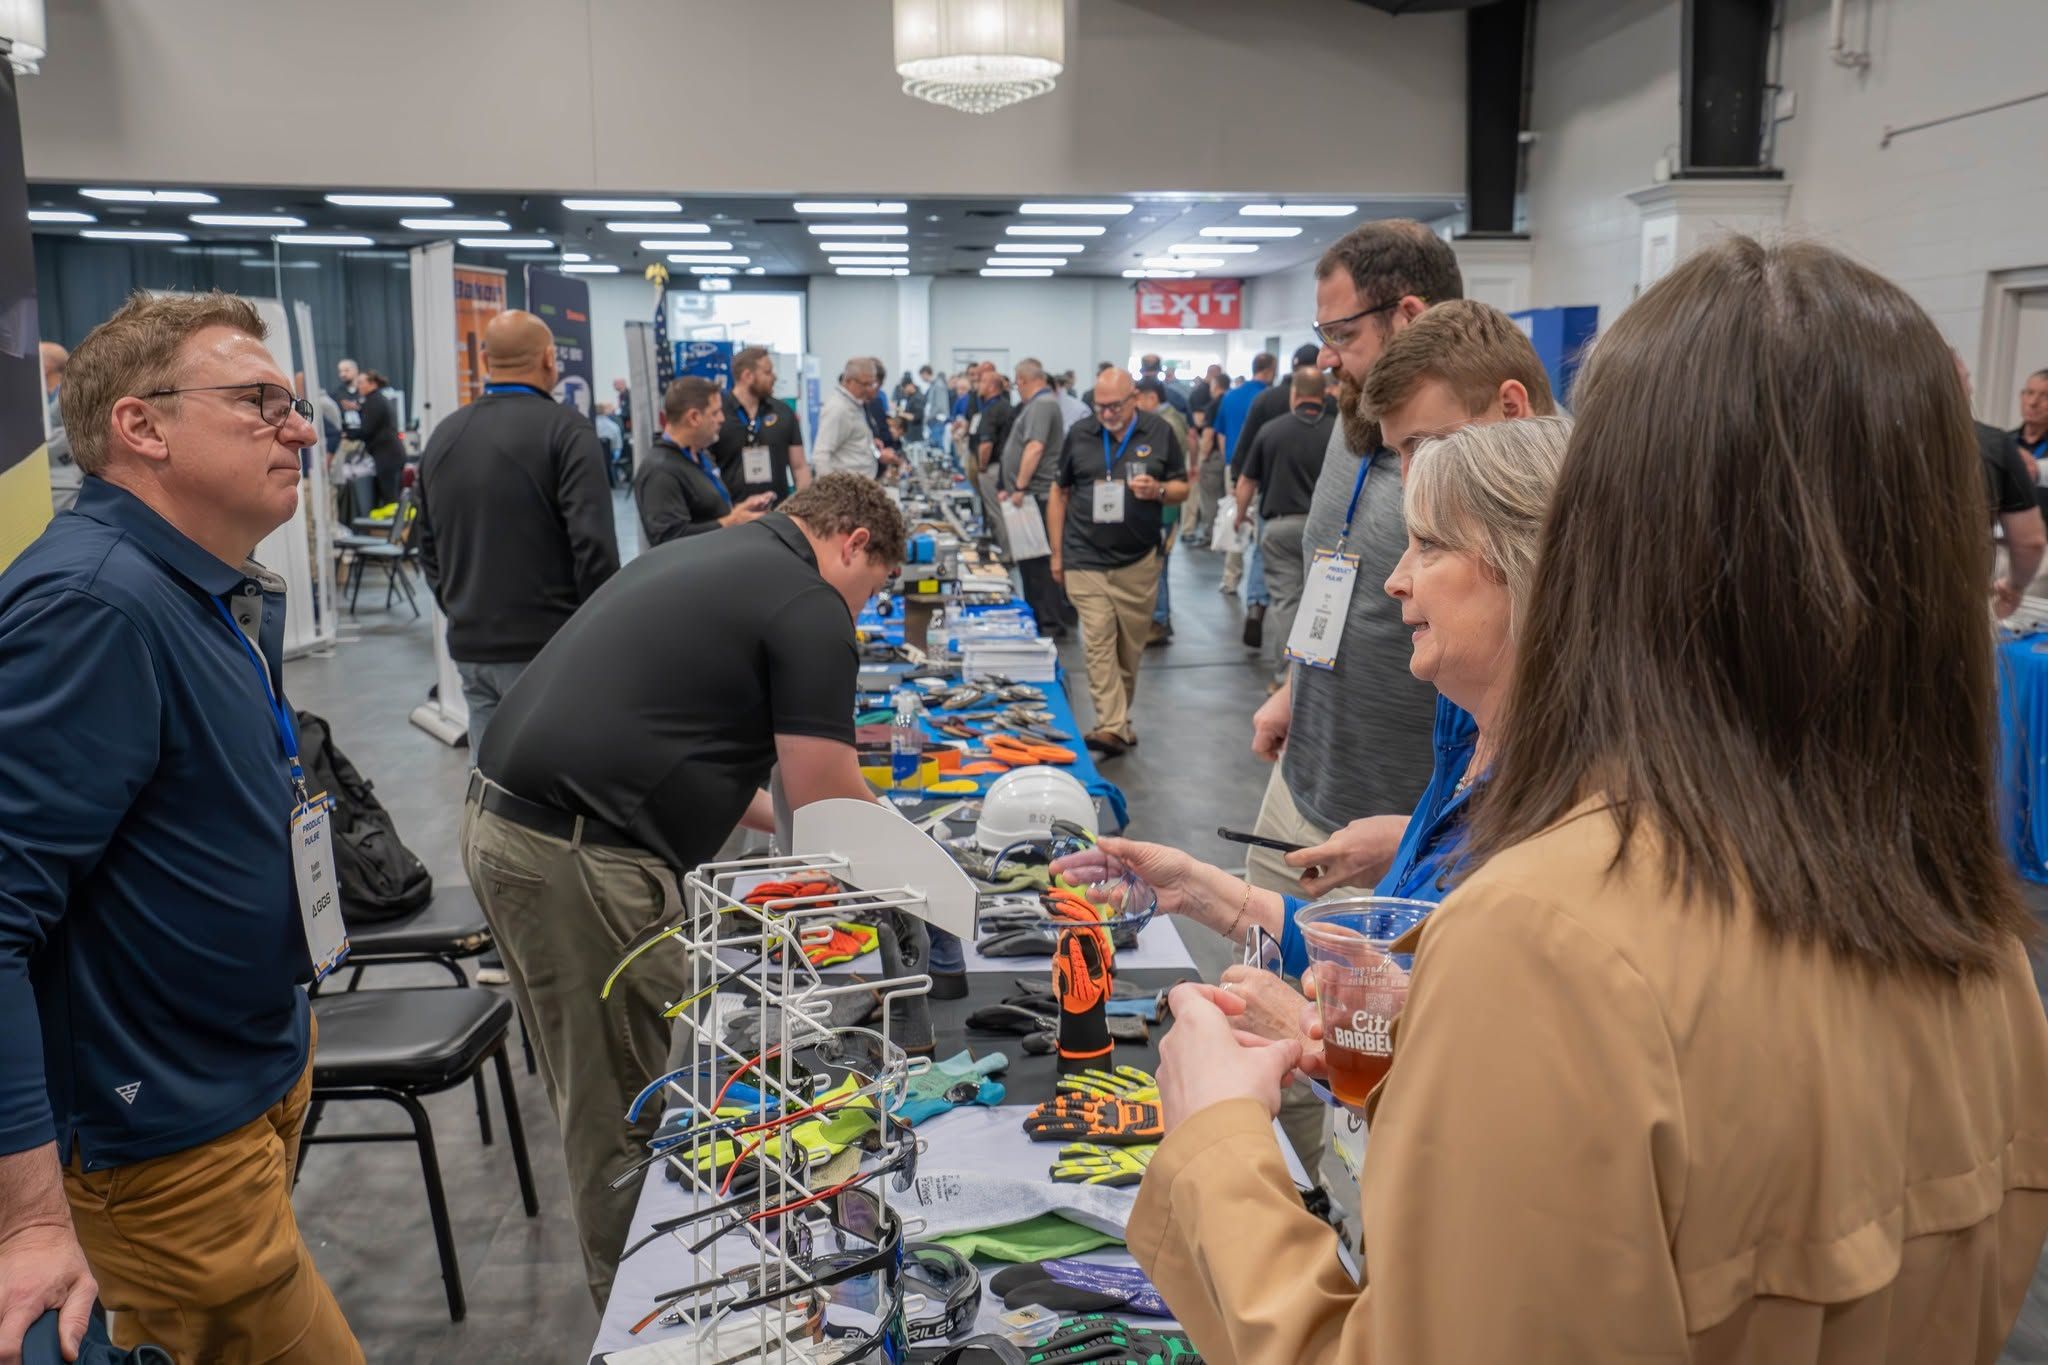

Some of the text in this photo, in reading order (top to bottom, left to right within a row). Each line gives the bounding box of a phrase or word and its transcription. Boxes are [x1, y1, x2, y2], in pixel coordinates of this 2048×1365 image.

[1141, 293, 1237, 315] EXIT
[302, 814, 325, 834] PRODUCT
[304, 831, 320, 847] PULSE
